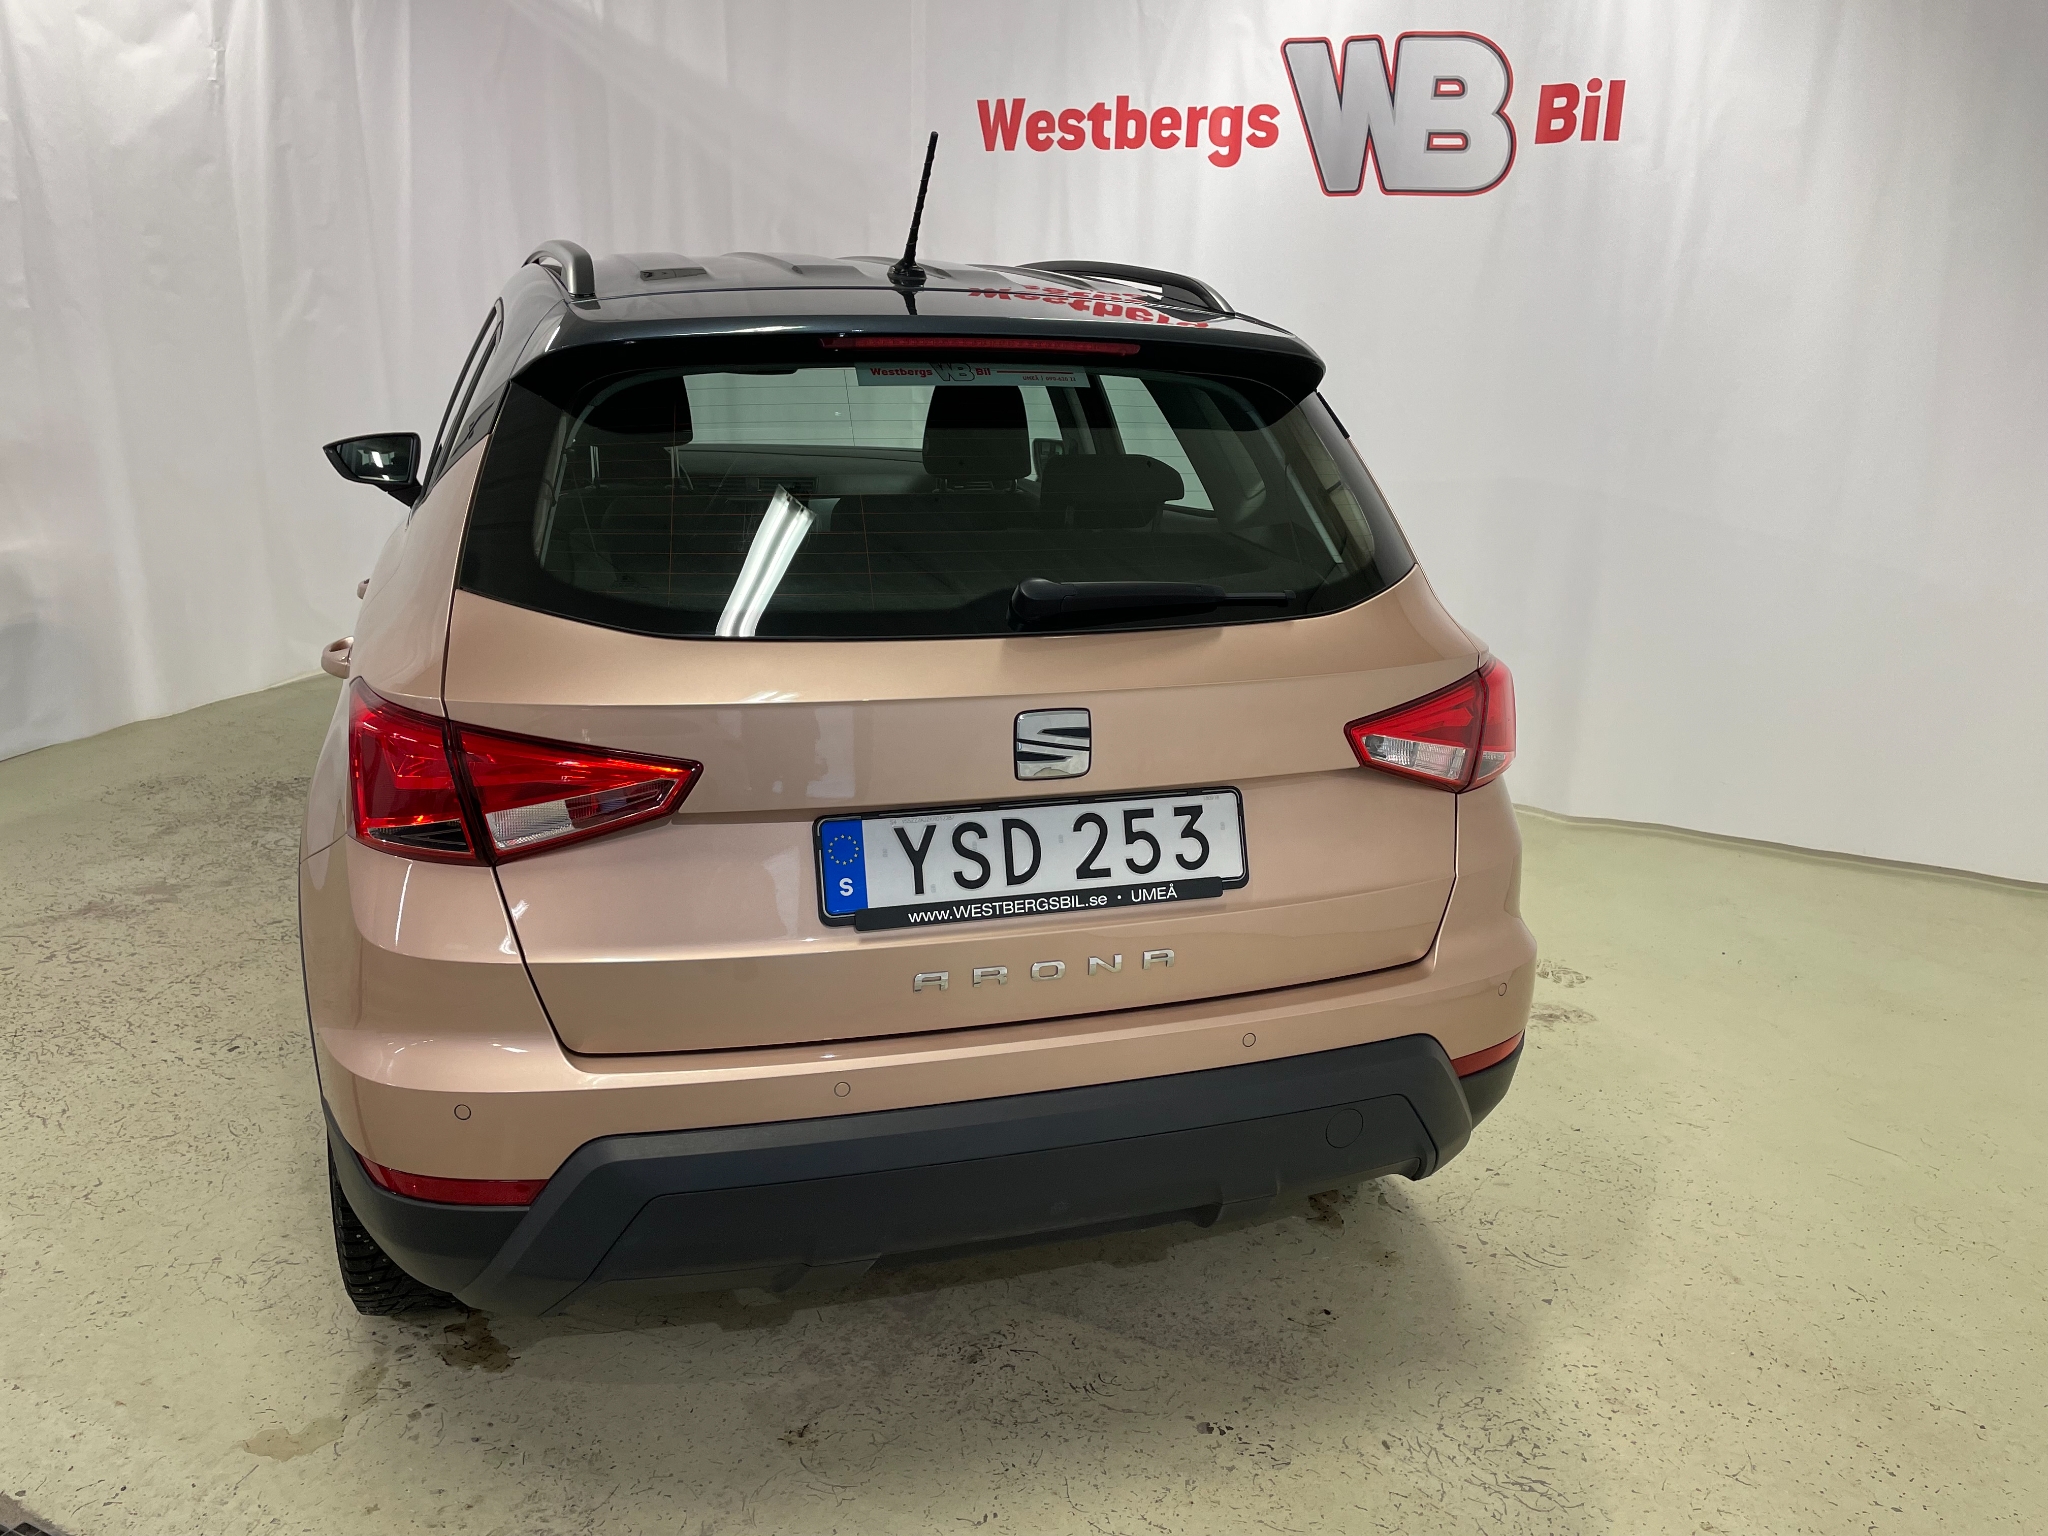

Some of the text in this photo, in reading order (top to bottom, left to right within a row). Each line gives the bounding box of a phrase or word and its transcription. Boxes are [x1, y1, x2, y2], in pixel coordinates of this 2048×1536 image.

[977, 31, 1627, 196] Westbergs WB Bil
[869, 362, 992, 381] Westbergs WB Bil
[893, 804, 1210, 896] YSD 253
[839, 877, 854, 897] S
[908, 883, 1178, 924] www.WESTBERGSBIL.se UMEÅ
[913, 948, 1176, 993] ARONA
